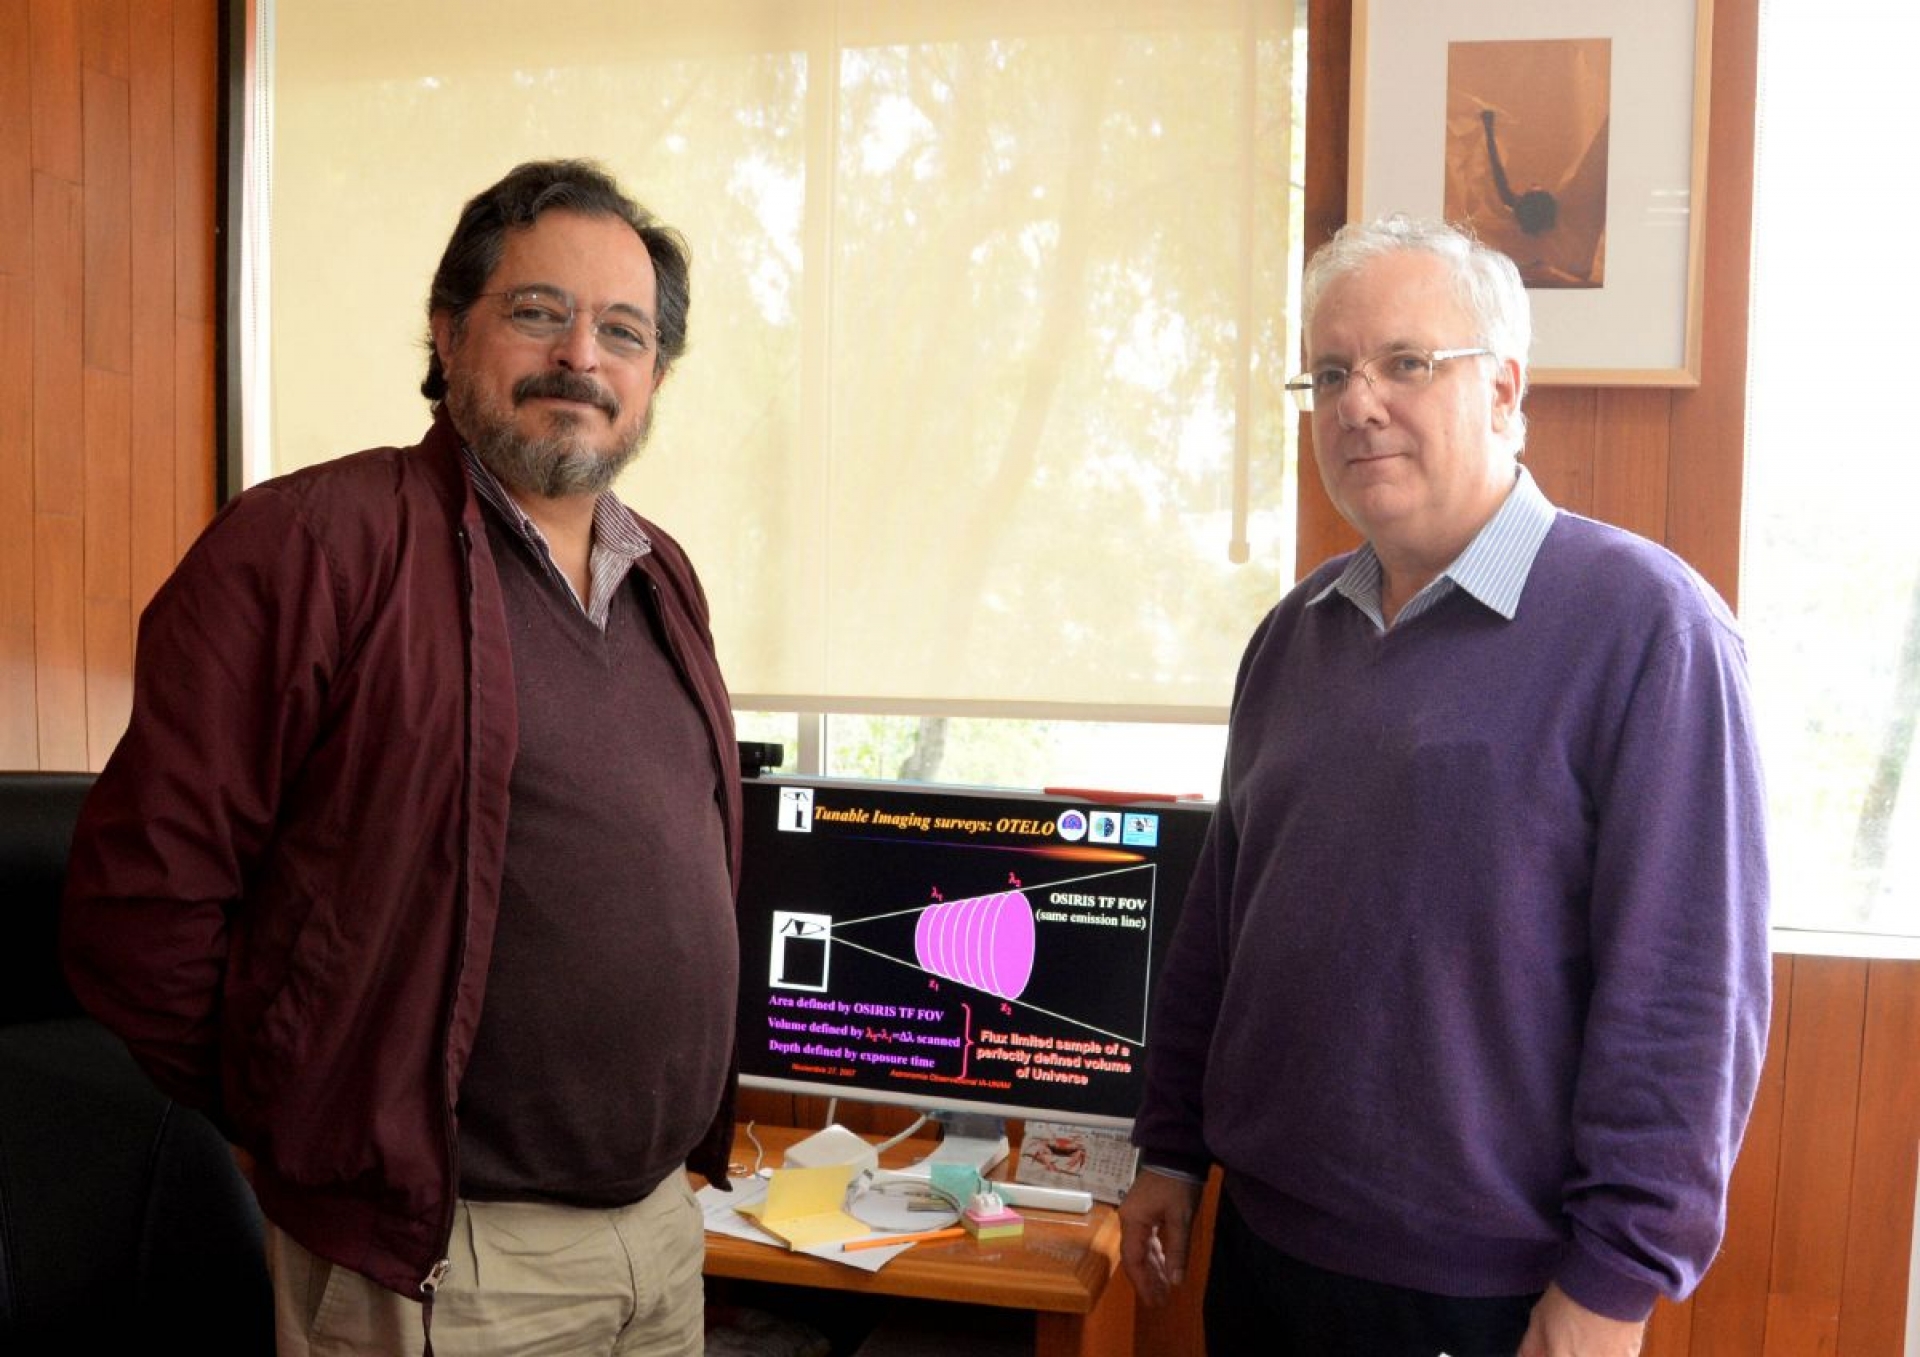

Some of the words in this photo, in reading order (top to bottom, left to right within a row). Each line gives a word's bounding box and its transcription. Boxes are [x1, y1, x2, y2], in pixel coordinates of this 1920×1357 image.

[814, 805, 870, 824] Tunable
[872, 809, 931, 832] Imaging
[933, 815, 993, 834] surveys:
[996, 818, 1055, 836] OTELO
[1050, 892, 1096, 908] OSIRIS
[1098, 895, 1116, 910] TF
[1117, 897, 1147, 912] FOV
[1035, 909, 1068, 923] (same
[1069, 911, 1118, 927] emission
[1120, 914, 1147, 931] line)
[768, 994, 795, 1008] Area
[796, 997, 836, 1012] defined
[837, 1001, 851, 1015] by
[853, 1003, 897, 1017] OSIRIS
[898, 1006, 916, 1020] TF
[917, 1008, 945, 1023] FOV
[768, 1016, 807, 1032] Volume
[809, 1020, 848, 1035] defined
[850, 1023, 865, 1039] by
[916, 1034, 961, 1048] scanned
[980, 1029, 1009, 1045] Flux
[1010, 1033, 1054, 1049] limited
[1056, 1038, 1102, 1055] sample
[1104, 1042, 1119, 1056] of
[1120, 1045, 1131, 1057] a
[768, 1039, 801, 1054] Depth
[803, 1042, 842, 1058] defined
[844, 1047, 857, 1061] by
[860, 1050, 908, 1065] exposure
[909, 1055, 935, 1068] time
[976, 1047, 1032, 1065] perfectly
[1033, 1051, 1083, 1068] defined
[1084, 1057, 1132, 1074] volume
[1015, 1066, 1031, 1079] of
[1031, 1068, 1089, 1086] Universe
